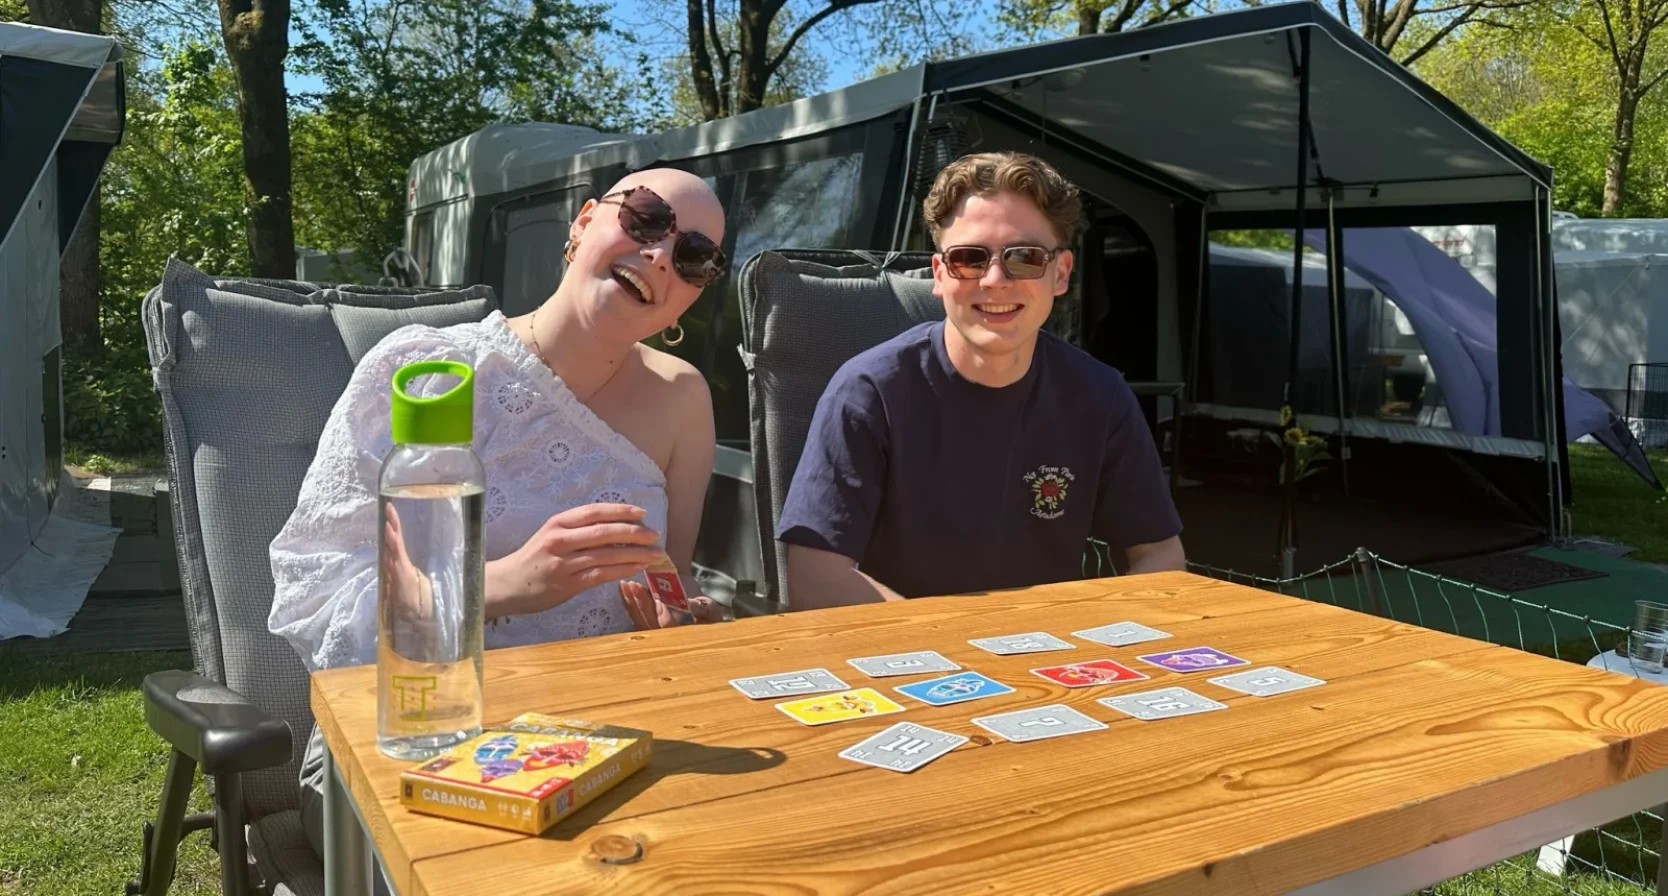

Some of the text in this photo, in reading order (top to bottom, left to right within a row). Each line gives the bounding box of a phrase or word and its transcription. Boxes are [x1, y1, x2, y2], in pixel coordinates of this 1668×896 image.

[392, 674, 437, 722] T
[876, 734, 933, 757] 14
[421, 787, 488, 812] CABANGA
